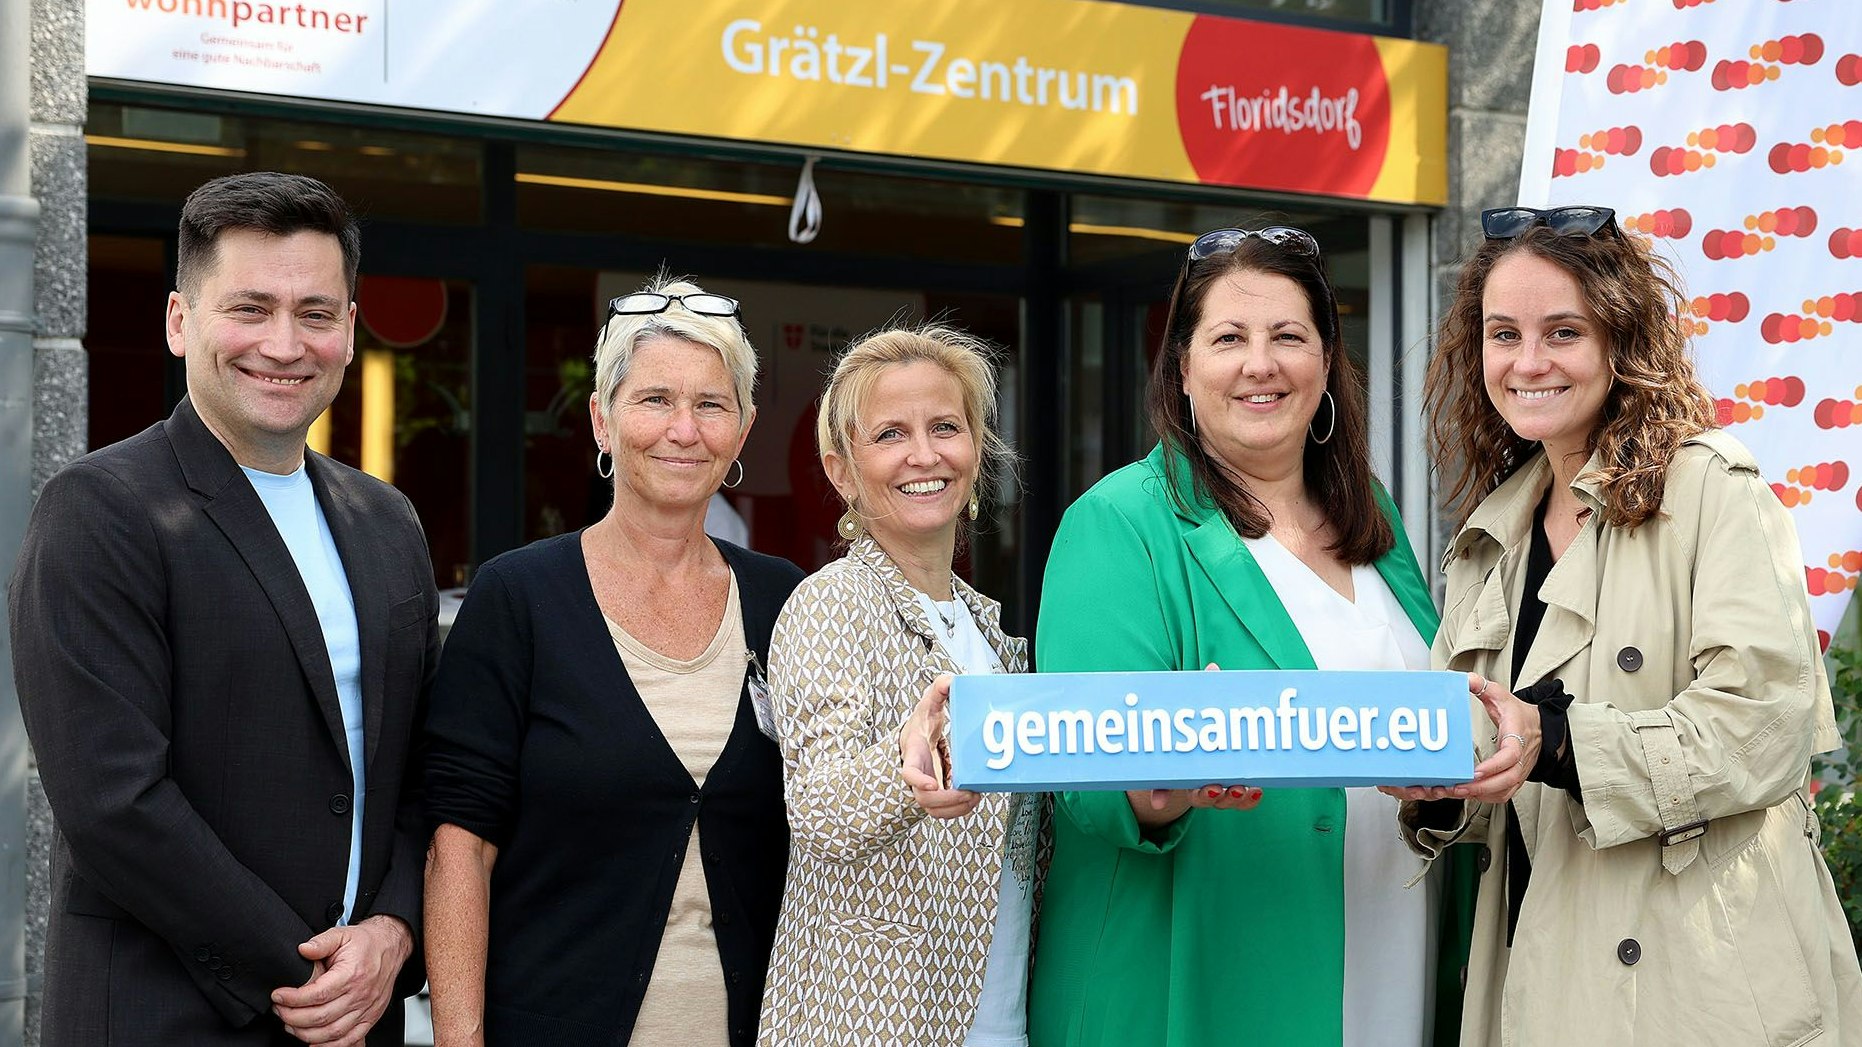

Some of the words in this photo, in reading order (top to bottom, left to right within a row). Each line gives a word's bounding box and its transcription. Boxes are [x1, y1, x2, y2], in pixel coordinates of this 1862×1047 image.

[172, 49, 200, 61] eine
[202, 52, 230, 66] gute
[721, 19, 1138, 117] Grätzl-Zentrum
[1201, 84, 1363, 151] Floridsdorf
[983, 687, 1449, 770] gemeinsamfuer.eu
